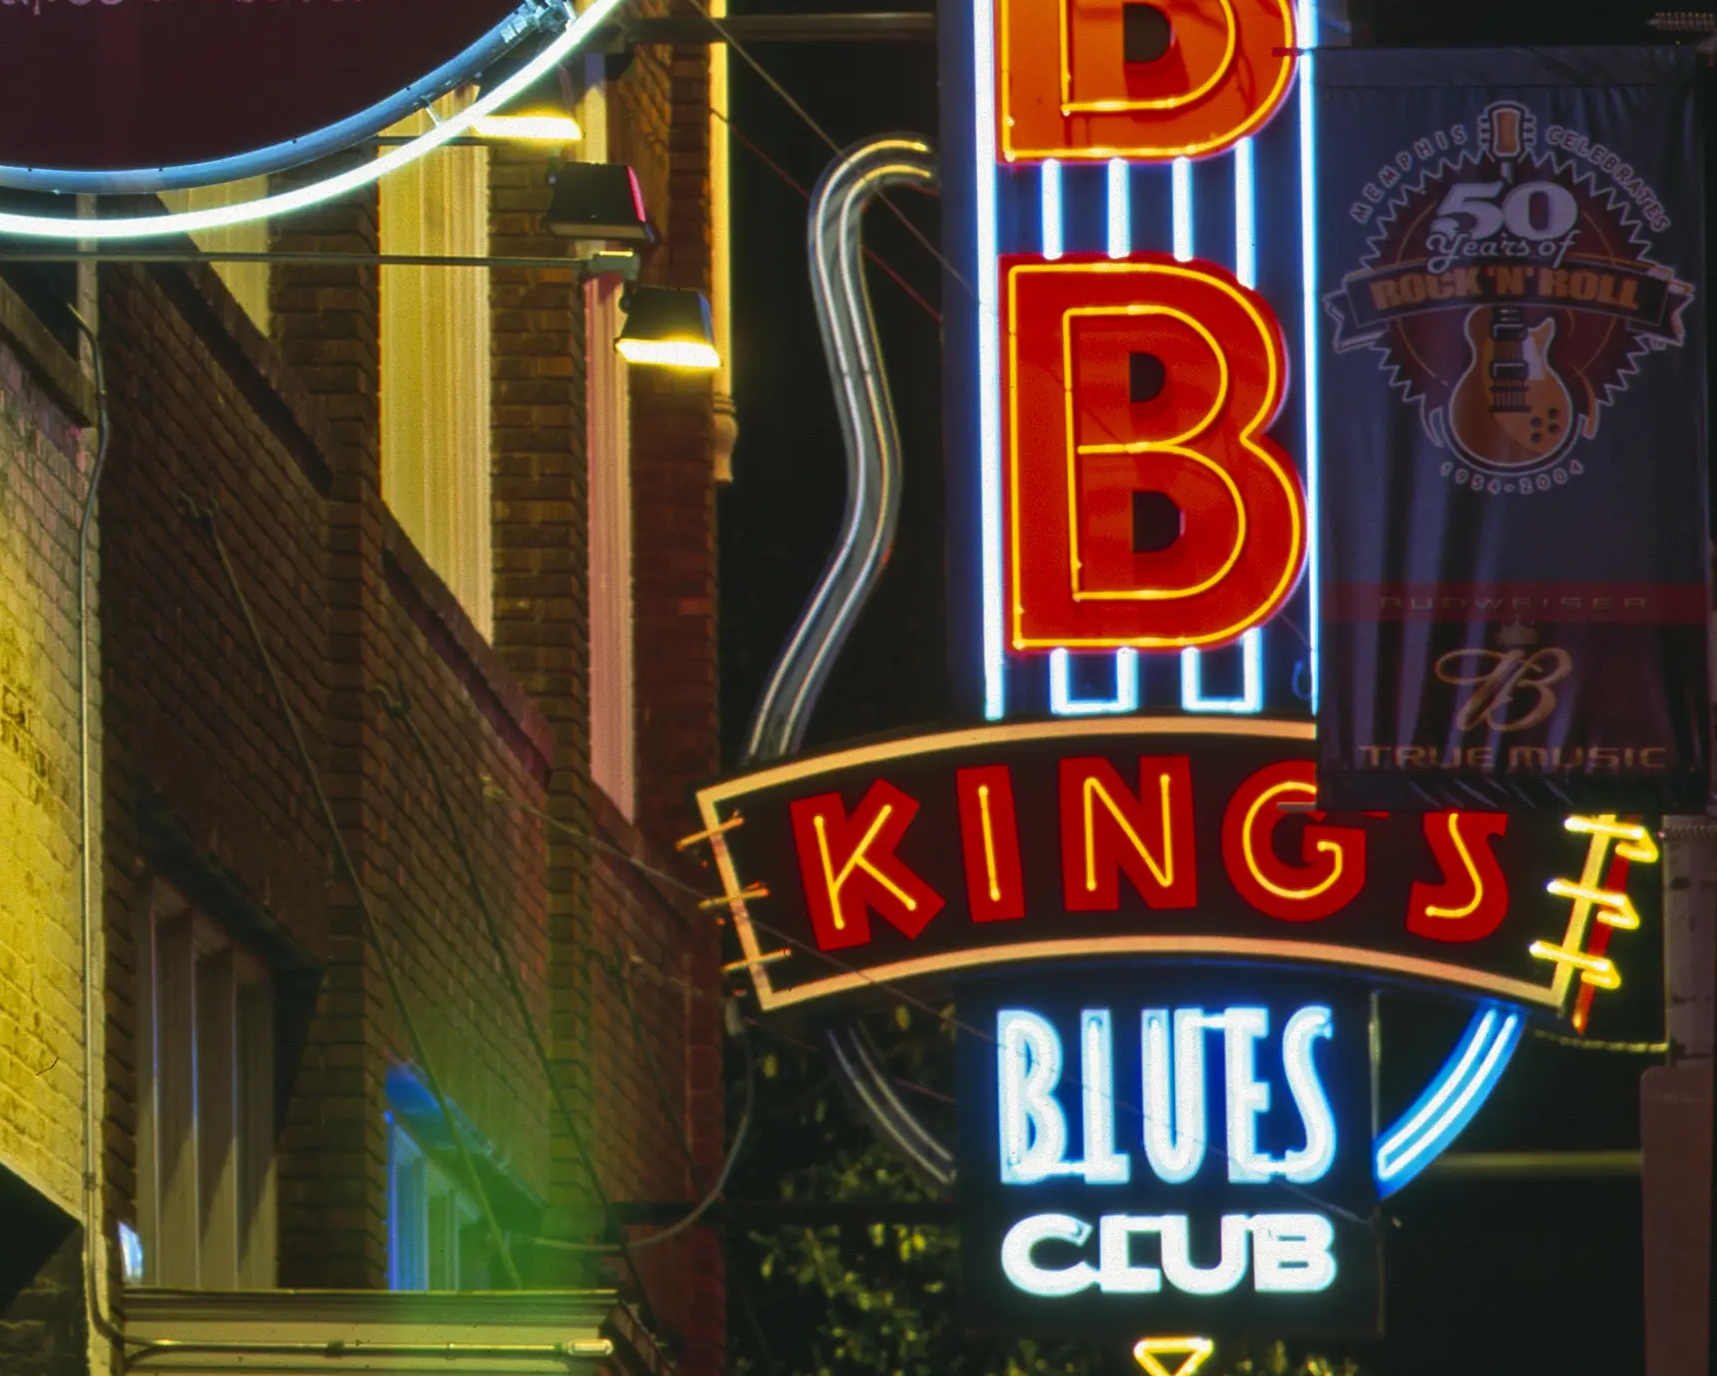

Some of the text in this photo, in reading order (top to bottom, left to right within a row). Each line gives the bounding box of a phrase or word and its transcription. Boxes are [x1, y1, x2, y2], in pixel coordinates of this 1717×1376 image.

[1350, 125, 1671, 234] MEMPHIS CELEBRATES
[1430, 180, 1579, 243] 50
[1425, 229, 1582, 275] Years of
[1370, 266, 1482, 311] ROCK
[1538, 268, 1639, 311] ROLL
[1439, 459, 1584, 495] 1954-2004
[1358, 745, 1667, 770] TRUE MUSIC
[996, 1005, 1336, 1185] BLUES
[1000, 1210, 1337, 1296] CLUB
